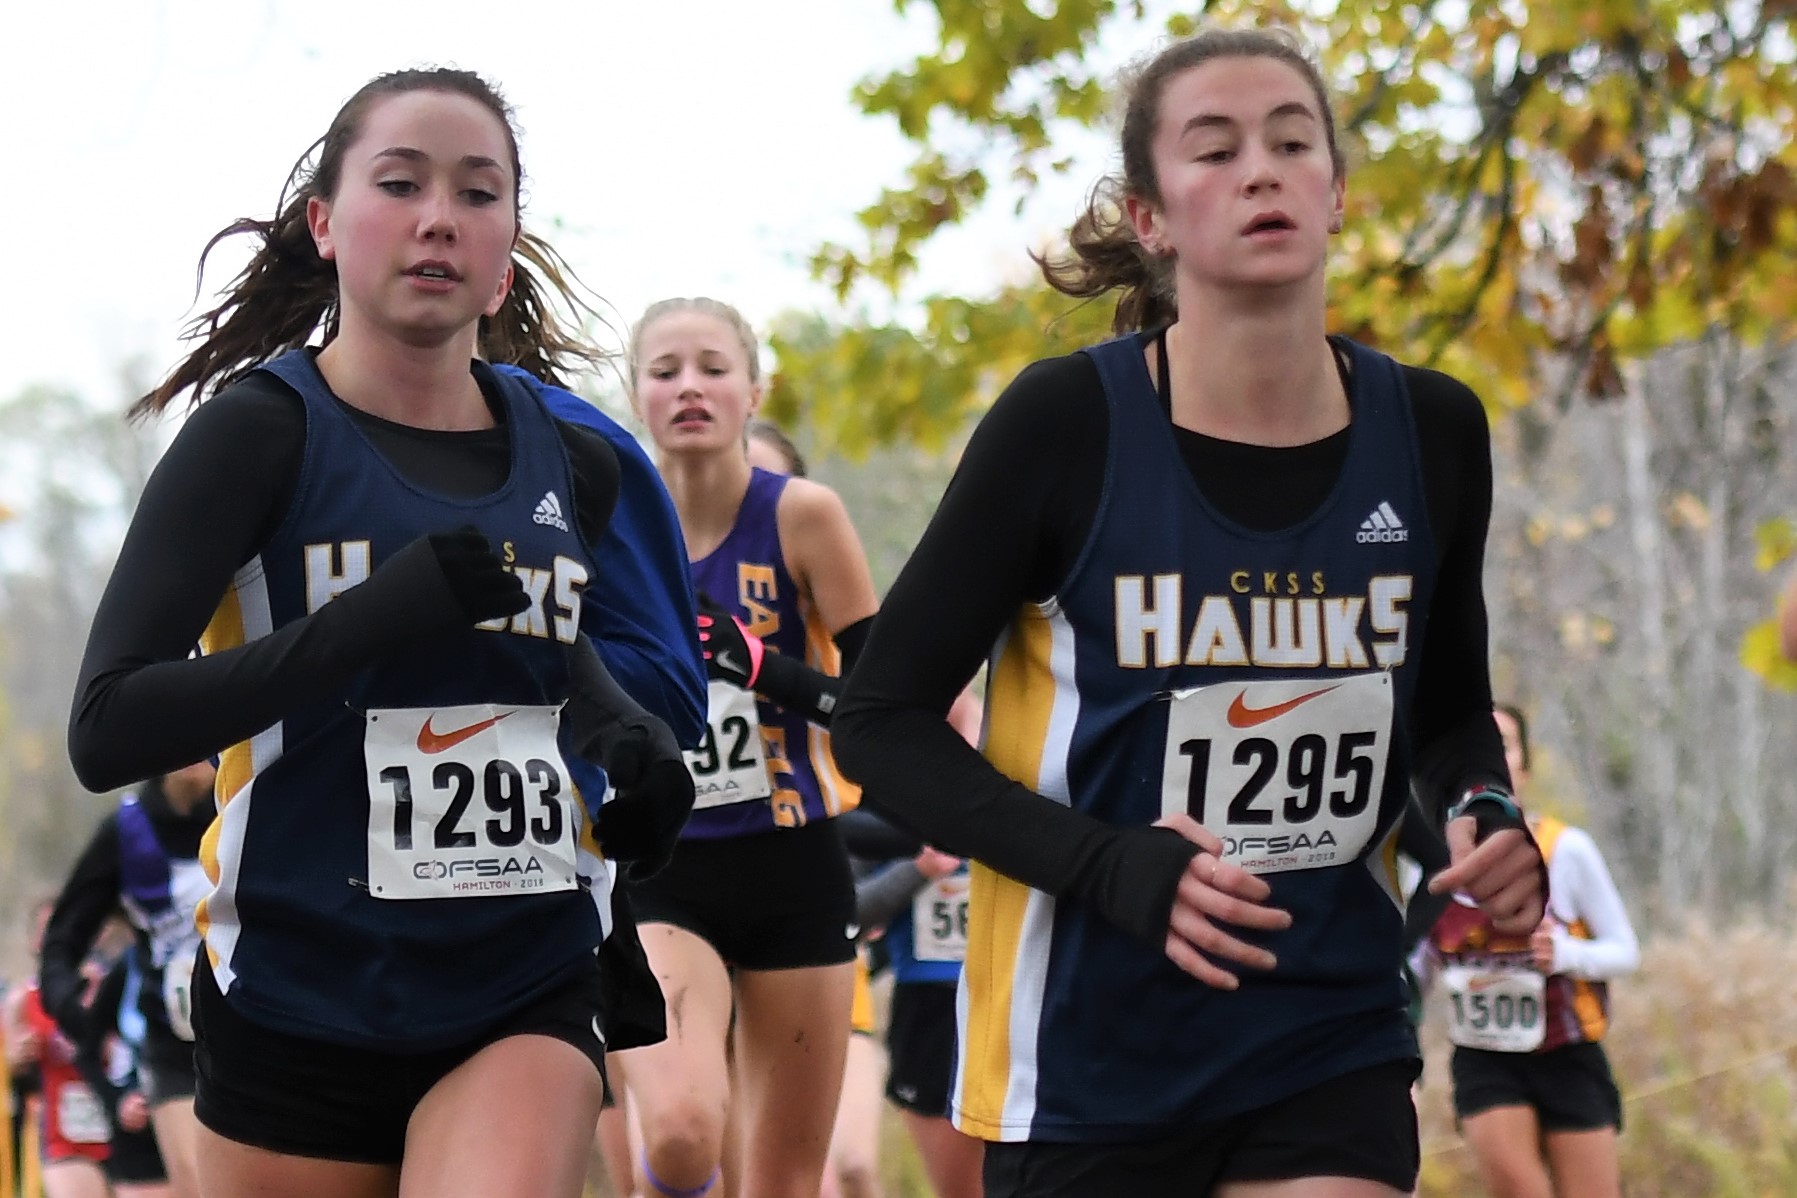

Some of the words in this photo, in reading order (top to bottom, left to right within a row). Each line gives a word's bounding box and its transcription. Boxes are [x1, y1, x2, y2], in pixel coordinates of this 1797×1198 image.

[1356, 529, 1409, 543] adidas
[1230, 571, 1325, 595] CKSS
[1115, 574, 1414, 668] HAWKS
[1179, 731, 1378, 826] 1295
[379, 759, 563, 851] 1293
[1241, 856, 1298, 868] HAMILTON
[453, 880, 511, 892] HAMILTON
[1450, 991, 1539, 1029] 1500
